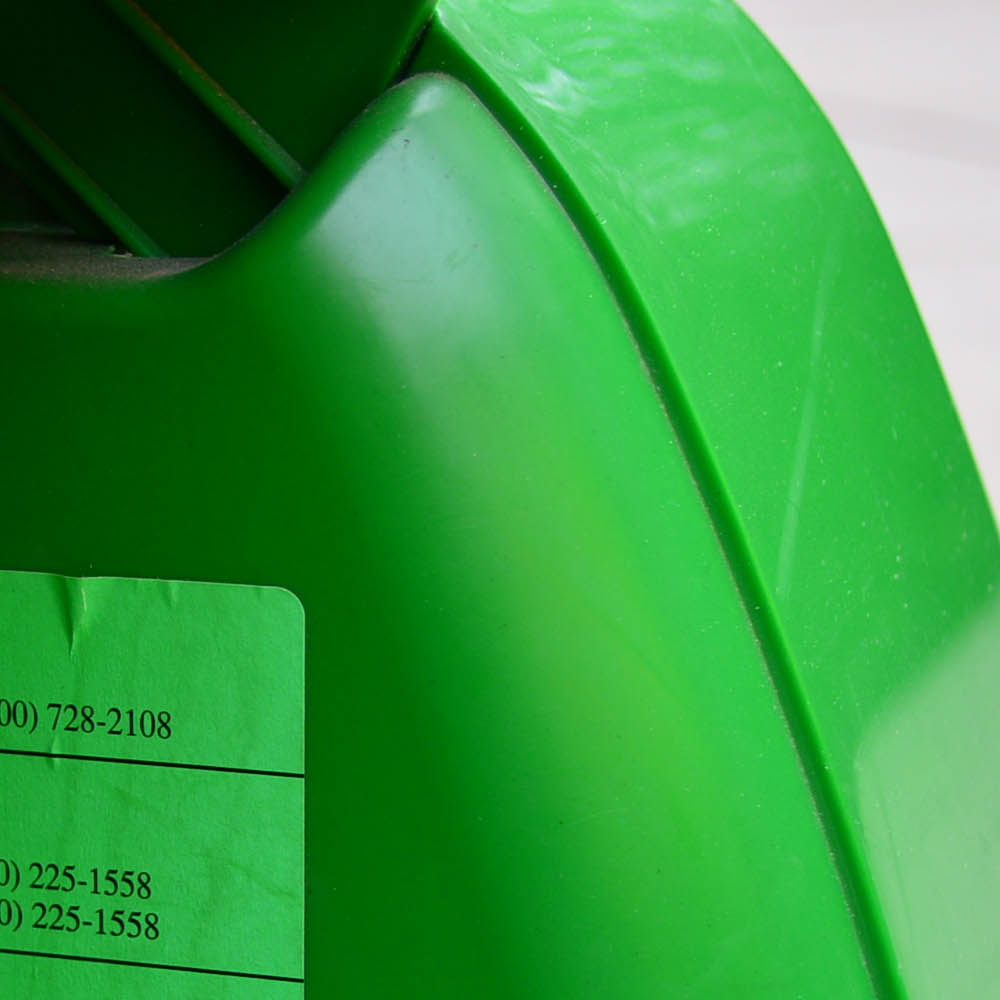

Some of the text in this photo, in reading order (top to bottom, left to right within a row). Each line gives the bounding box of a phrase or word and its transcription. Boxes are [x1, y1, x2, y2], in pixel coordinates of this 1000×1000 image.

[46, 702, 172, 740] 728-2108
[28, 861, 152, 900] 225-1558
[31, 901, 160, 941] 225-1558
